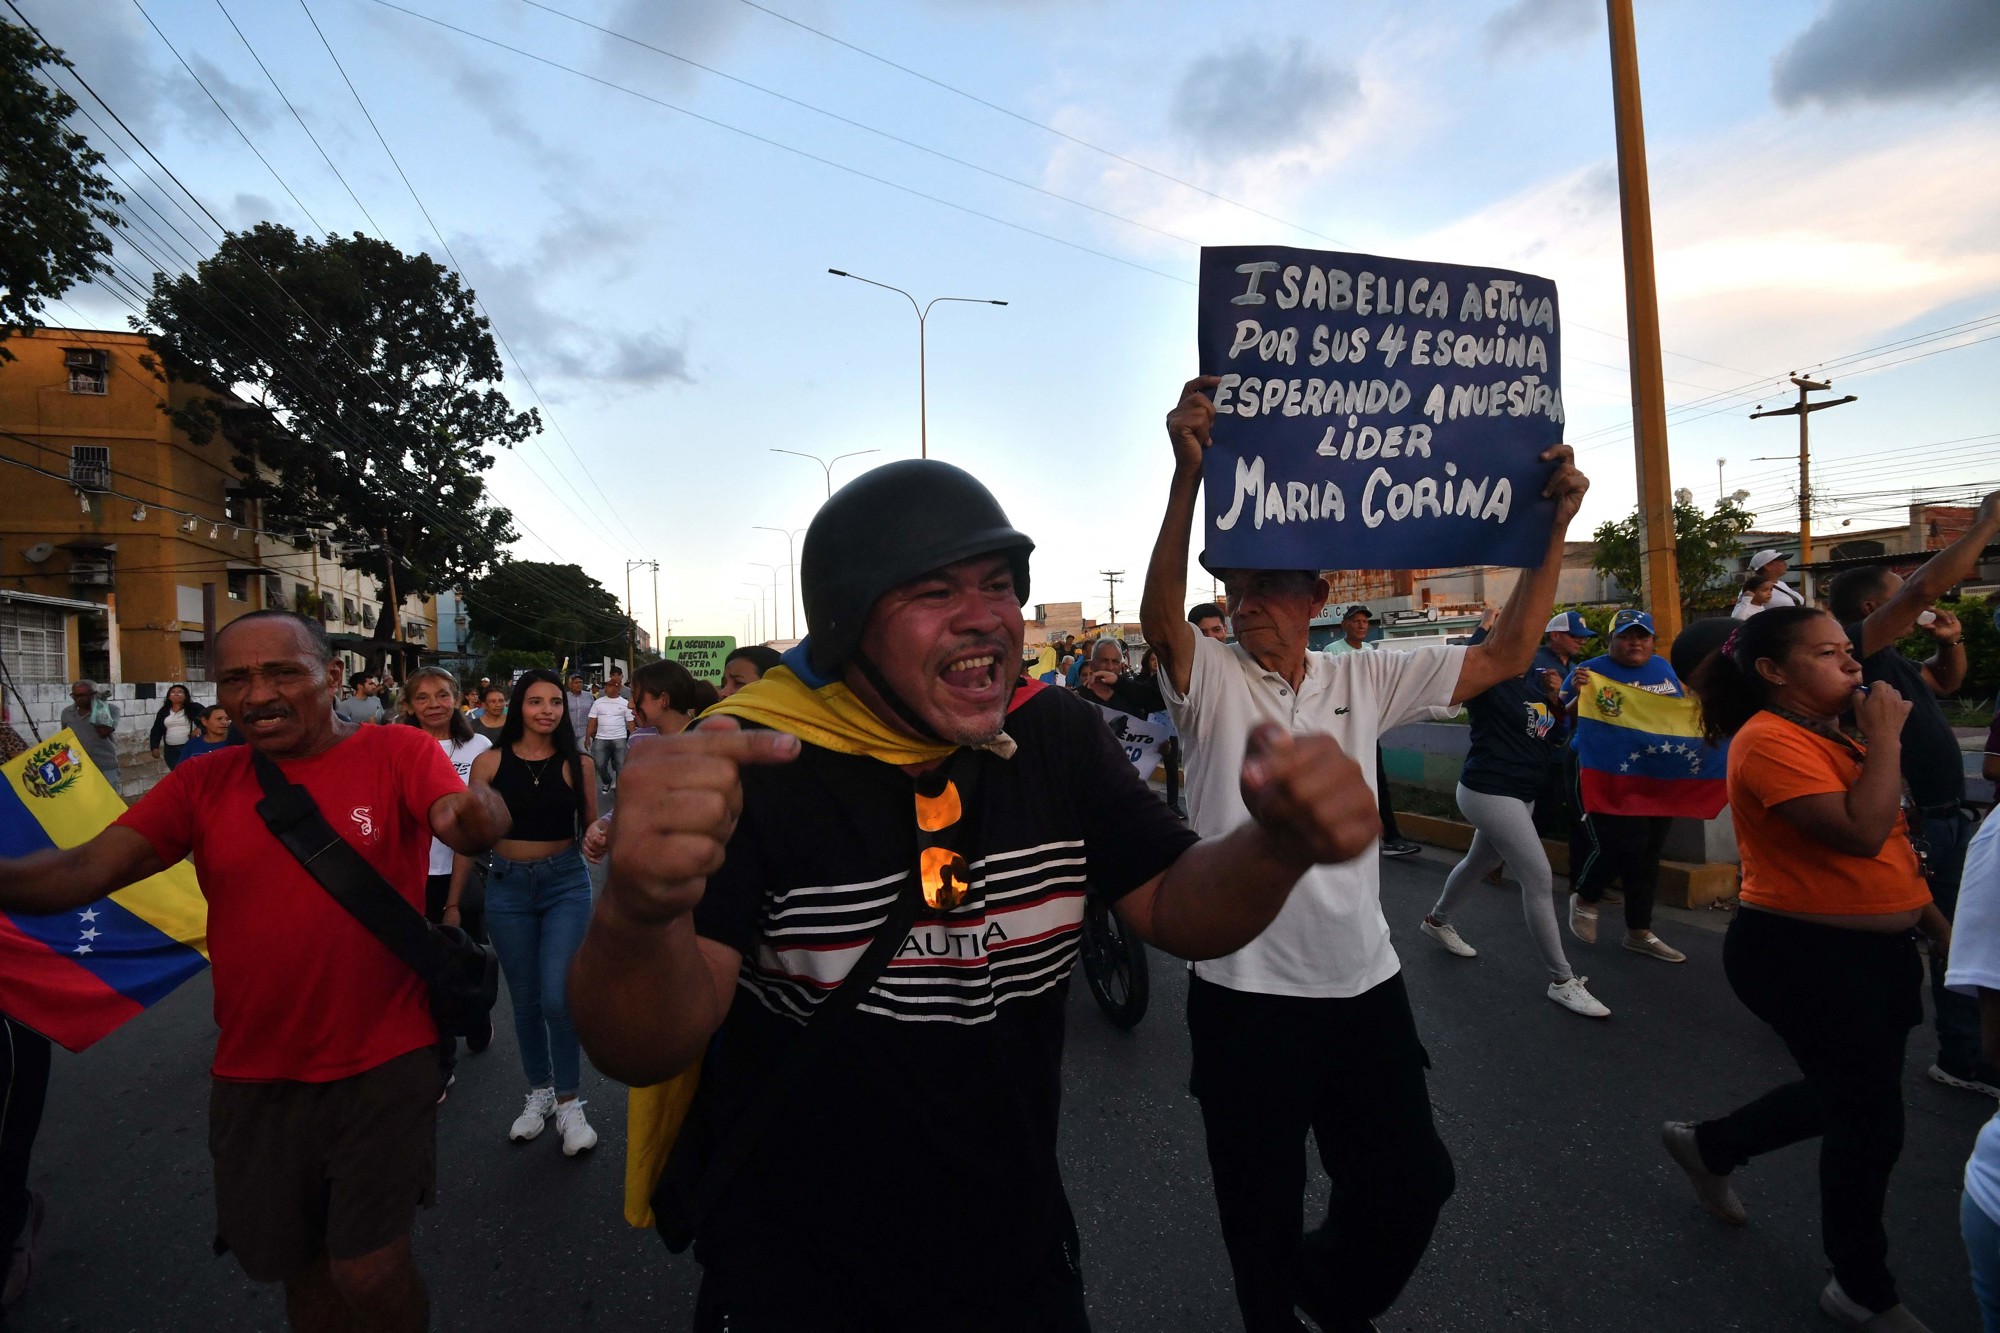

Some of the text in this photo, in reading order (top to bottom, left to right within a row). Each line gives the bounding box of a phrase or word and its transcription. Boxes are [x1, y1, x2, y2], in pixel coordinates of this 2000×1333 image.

[1231, 261, 1449, 319] ISABELICA
[1228, 320, 1298, 366] POR
[1309, 324, 1370, 367] SUS
[1376, 323, 1407, 368] 4
[1213, 373, 1565, 424] ESPERANDO A NUESTRA
[669, 640, 725, 650] LA OSCURIDAD
[678, 651, 708, 660] AFECTA
[691, 669, 721, 677] NIDAD
